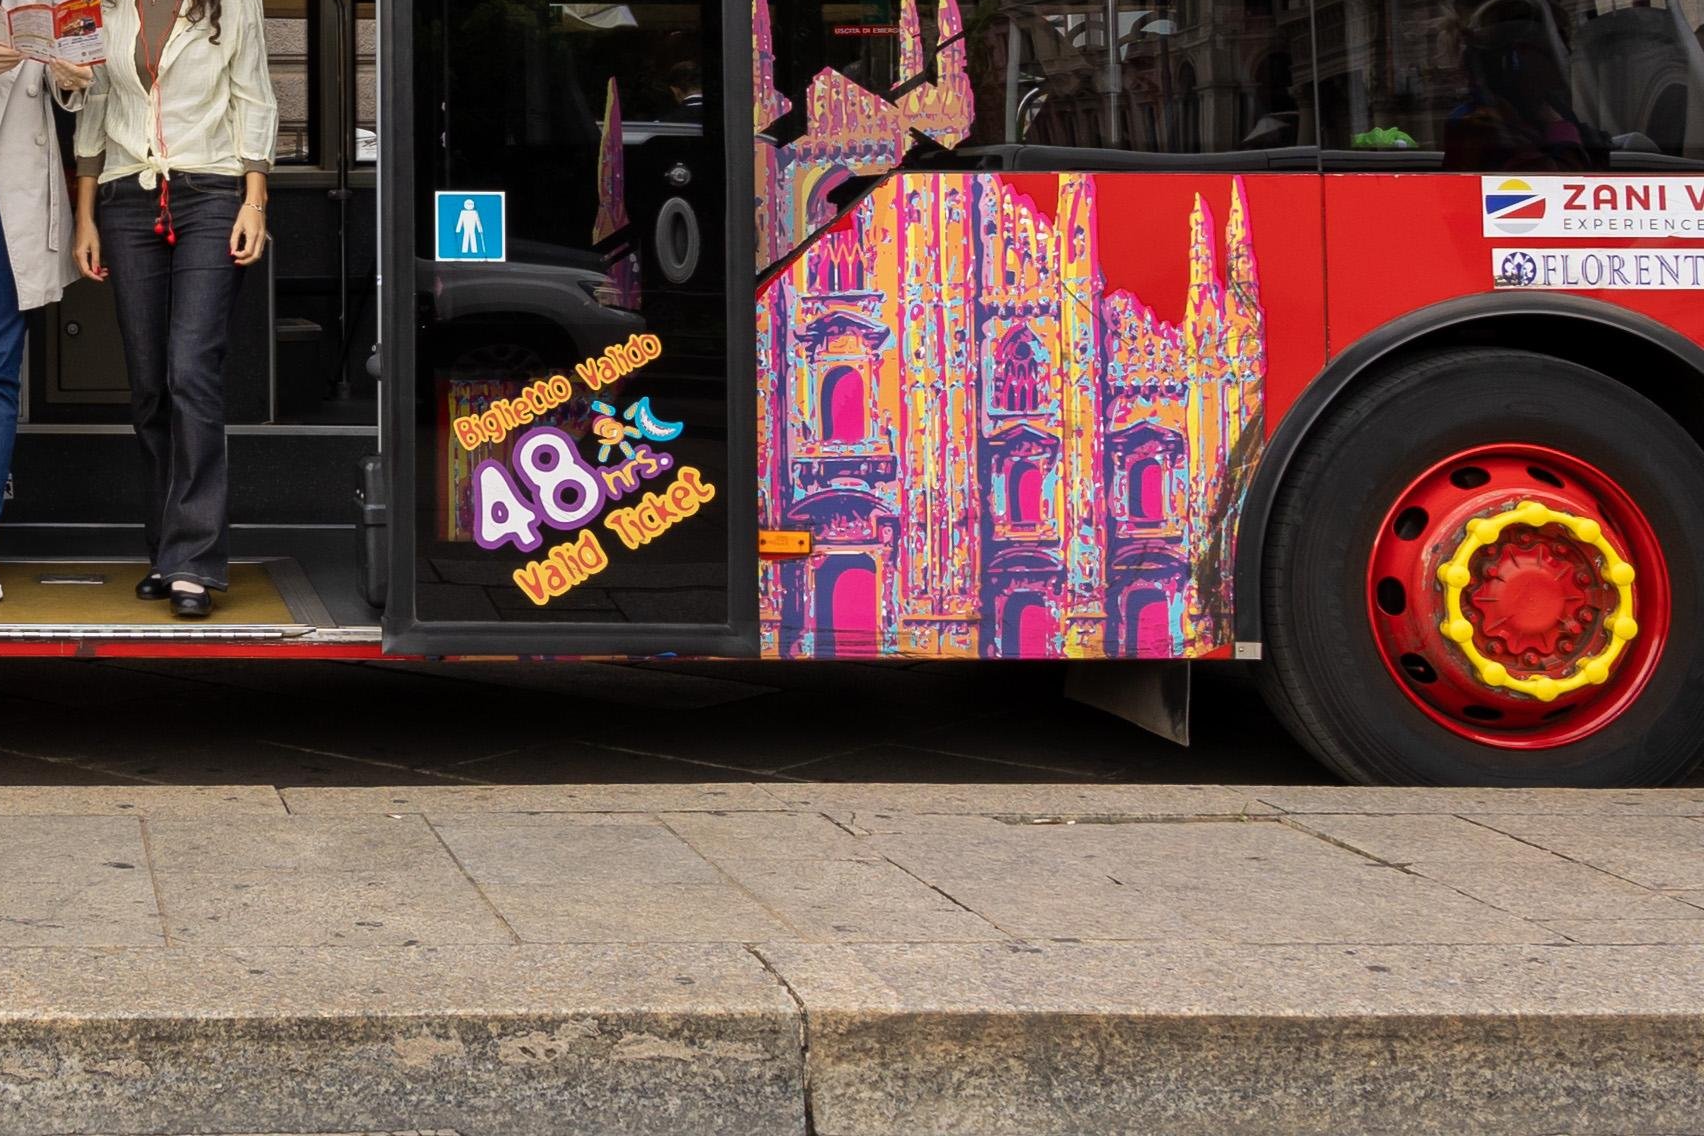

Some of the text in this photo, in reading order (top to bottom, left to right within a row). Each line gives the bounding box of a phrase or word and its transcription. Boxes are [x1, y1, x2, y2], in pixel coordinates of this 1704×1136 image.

[1563, 184, 1667, 211] ZANI
[1563, 218, 1704, 231] EXPERIENCE
[1542, 254, 1704, 286] FLORENT
[453, 334, 661, 450] Biglietto Valido
[474, 426, 606, 552] 48
[513, 467, 715, 605] Valid Ticket
